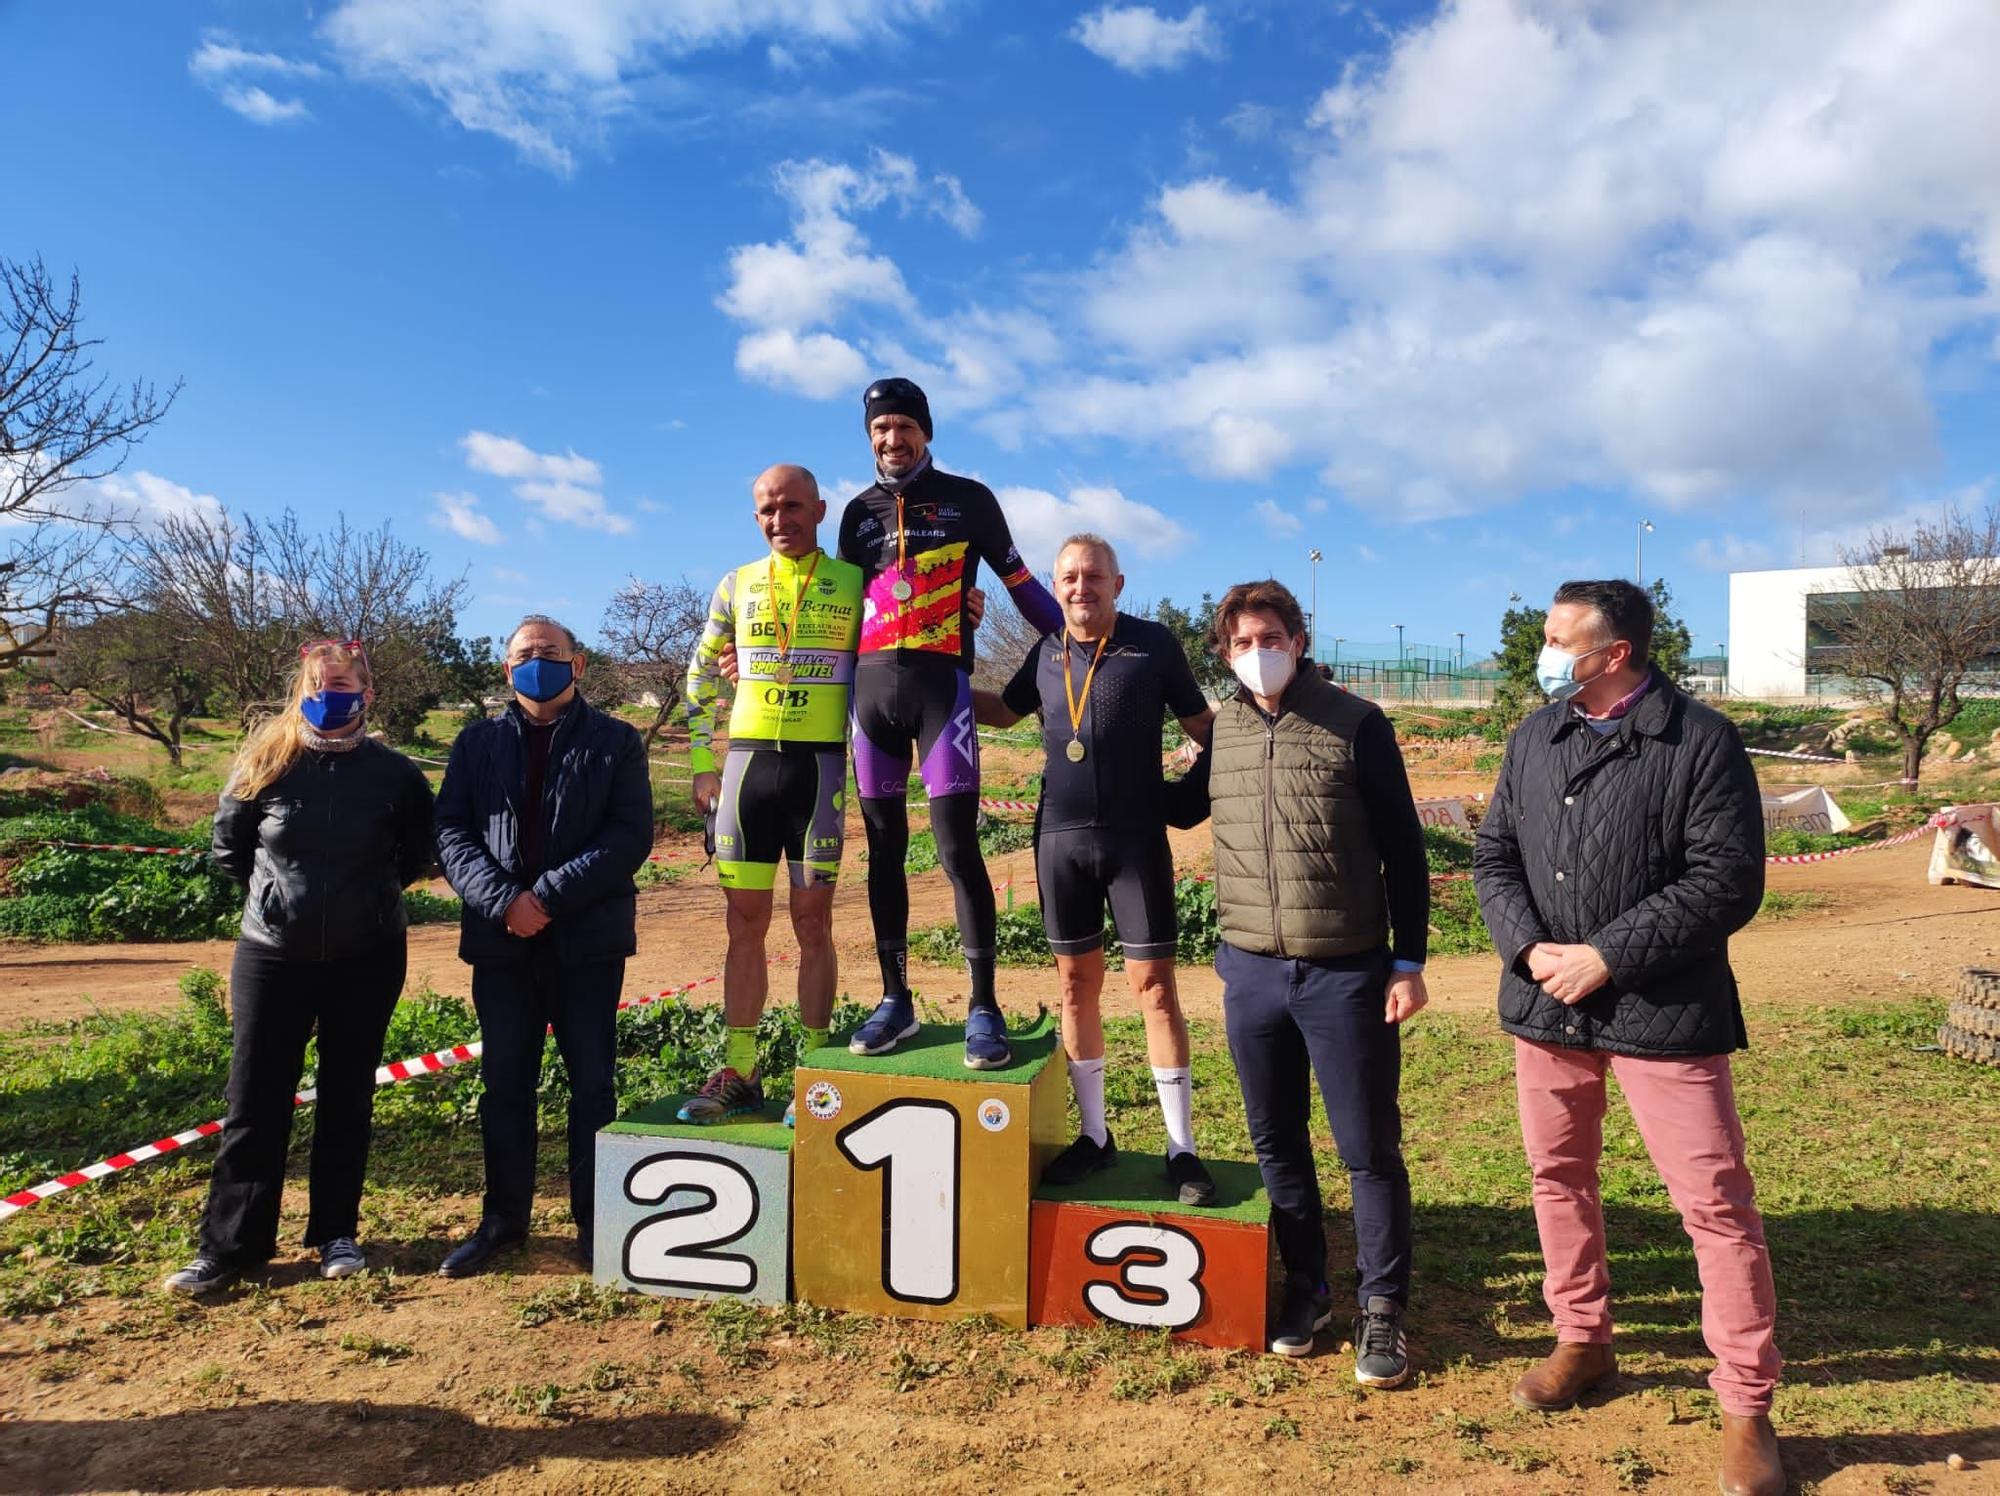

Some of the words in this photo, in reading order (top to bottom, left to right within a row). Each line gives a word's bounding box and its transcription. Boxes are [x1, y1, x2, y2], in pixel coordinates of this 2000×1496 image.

[904, 529, 946, 537] BALEARS
[794, 663, 834, 678] HOTEL
[622, 1150, 759, 1293] 2
[835, 1097, 960, 1305] 1
[1082, 1221, 1204, 1330] 3
